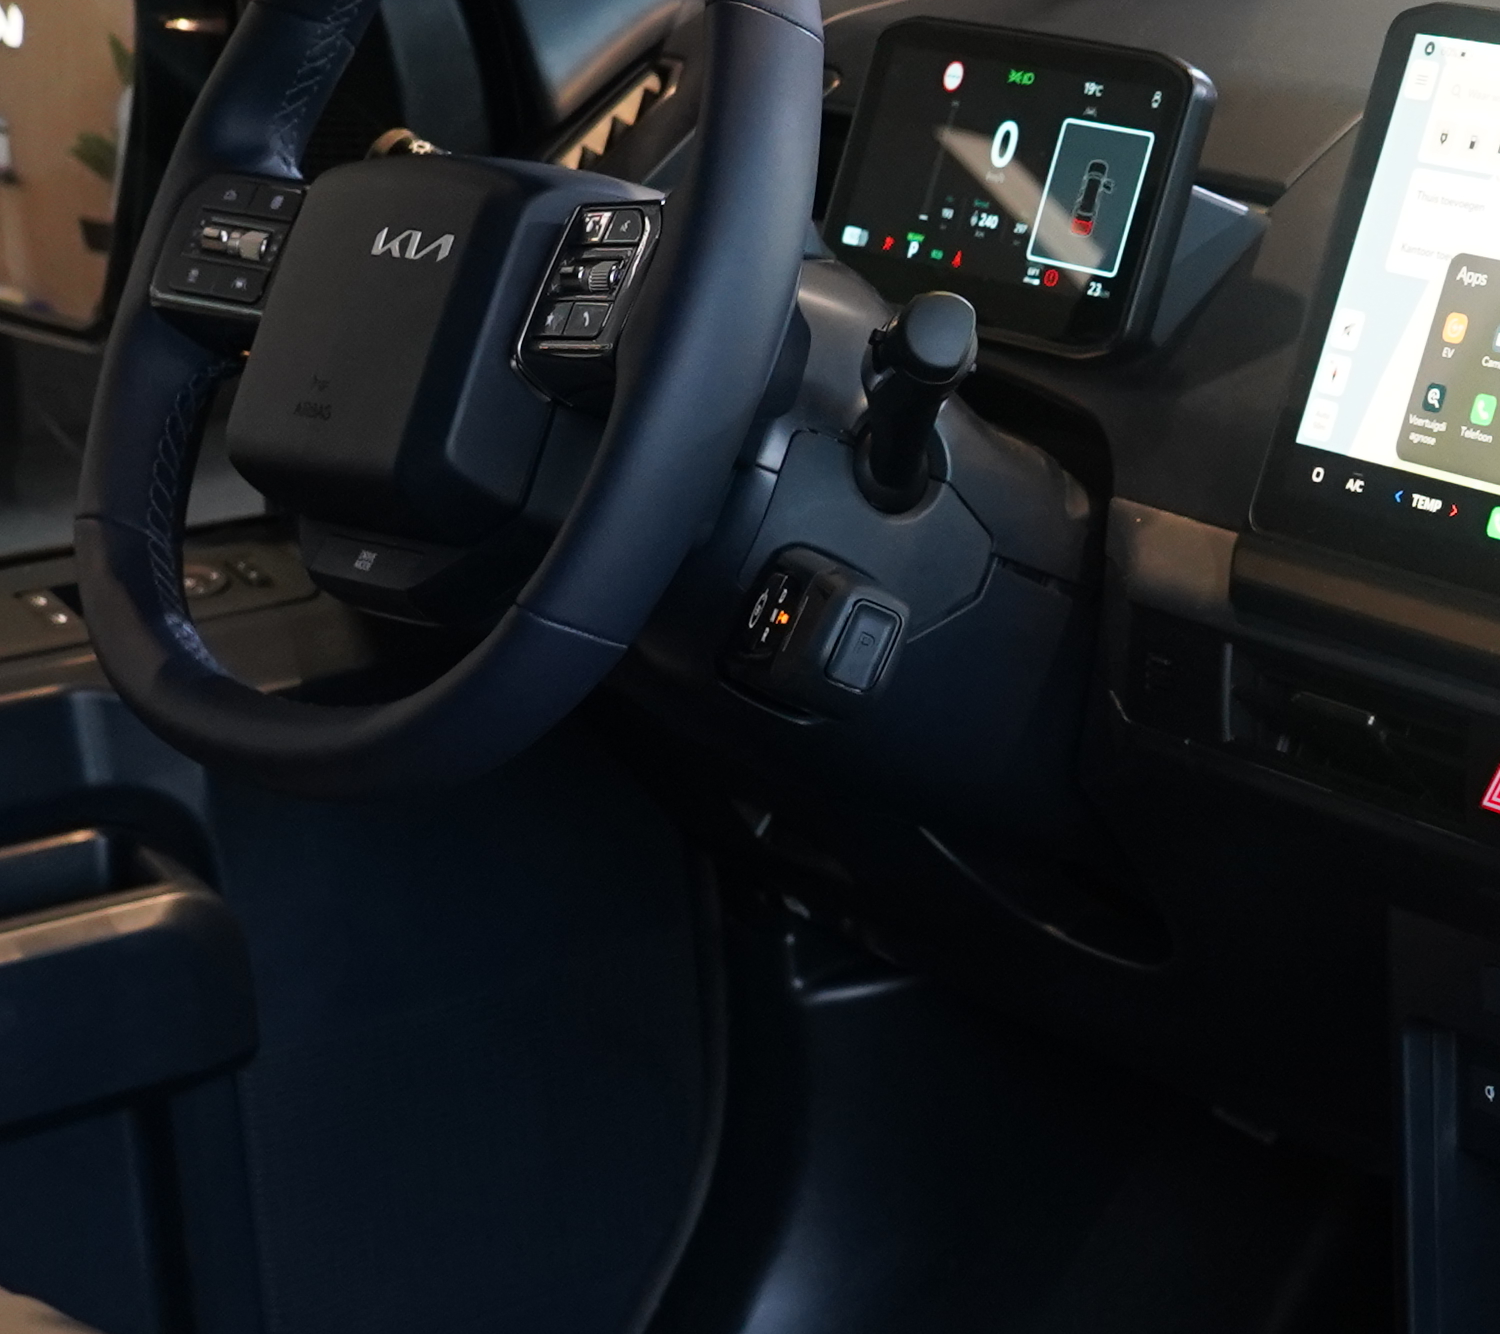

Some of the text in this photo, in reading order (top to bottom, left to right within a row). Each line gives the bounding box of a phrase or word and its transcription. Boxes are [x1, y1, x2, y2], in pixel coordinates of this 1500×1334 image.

[991, 119, 1019, 168] 0
[1417, 190, 1485, 213] Thuis toevoegen
[978, 213, 999, 229] 240
[370, 226, 455, 262] KIA
[907, 241, 920, 258] P
[1400, 243, 1435, 258] Kantoor
[1456, 266, 1488, 287] Apps
[1087, 281, 1102, 296] 23
[1442, 347, 1455, 359] EV
[1409, 414, 1447, 432] Voertuigdi
[1409, 432, 1436, 446] agnose
[1460, 427, 1493, 443] Telefoon
[1345, 478, 1365, 494] A/C
[1411, 493, 1443, 514] TEMP
